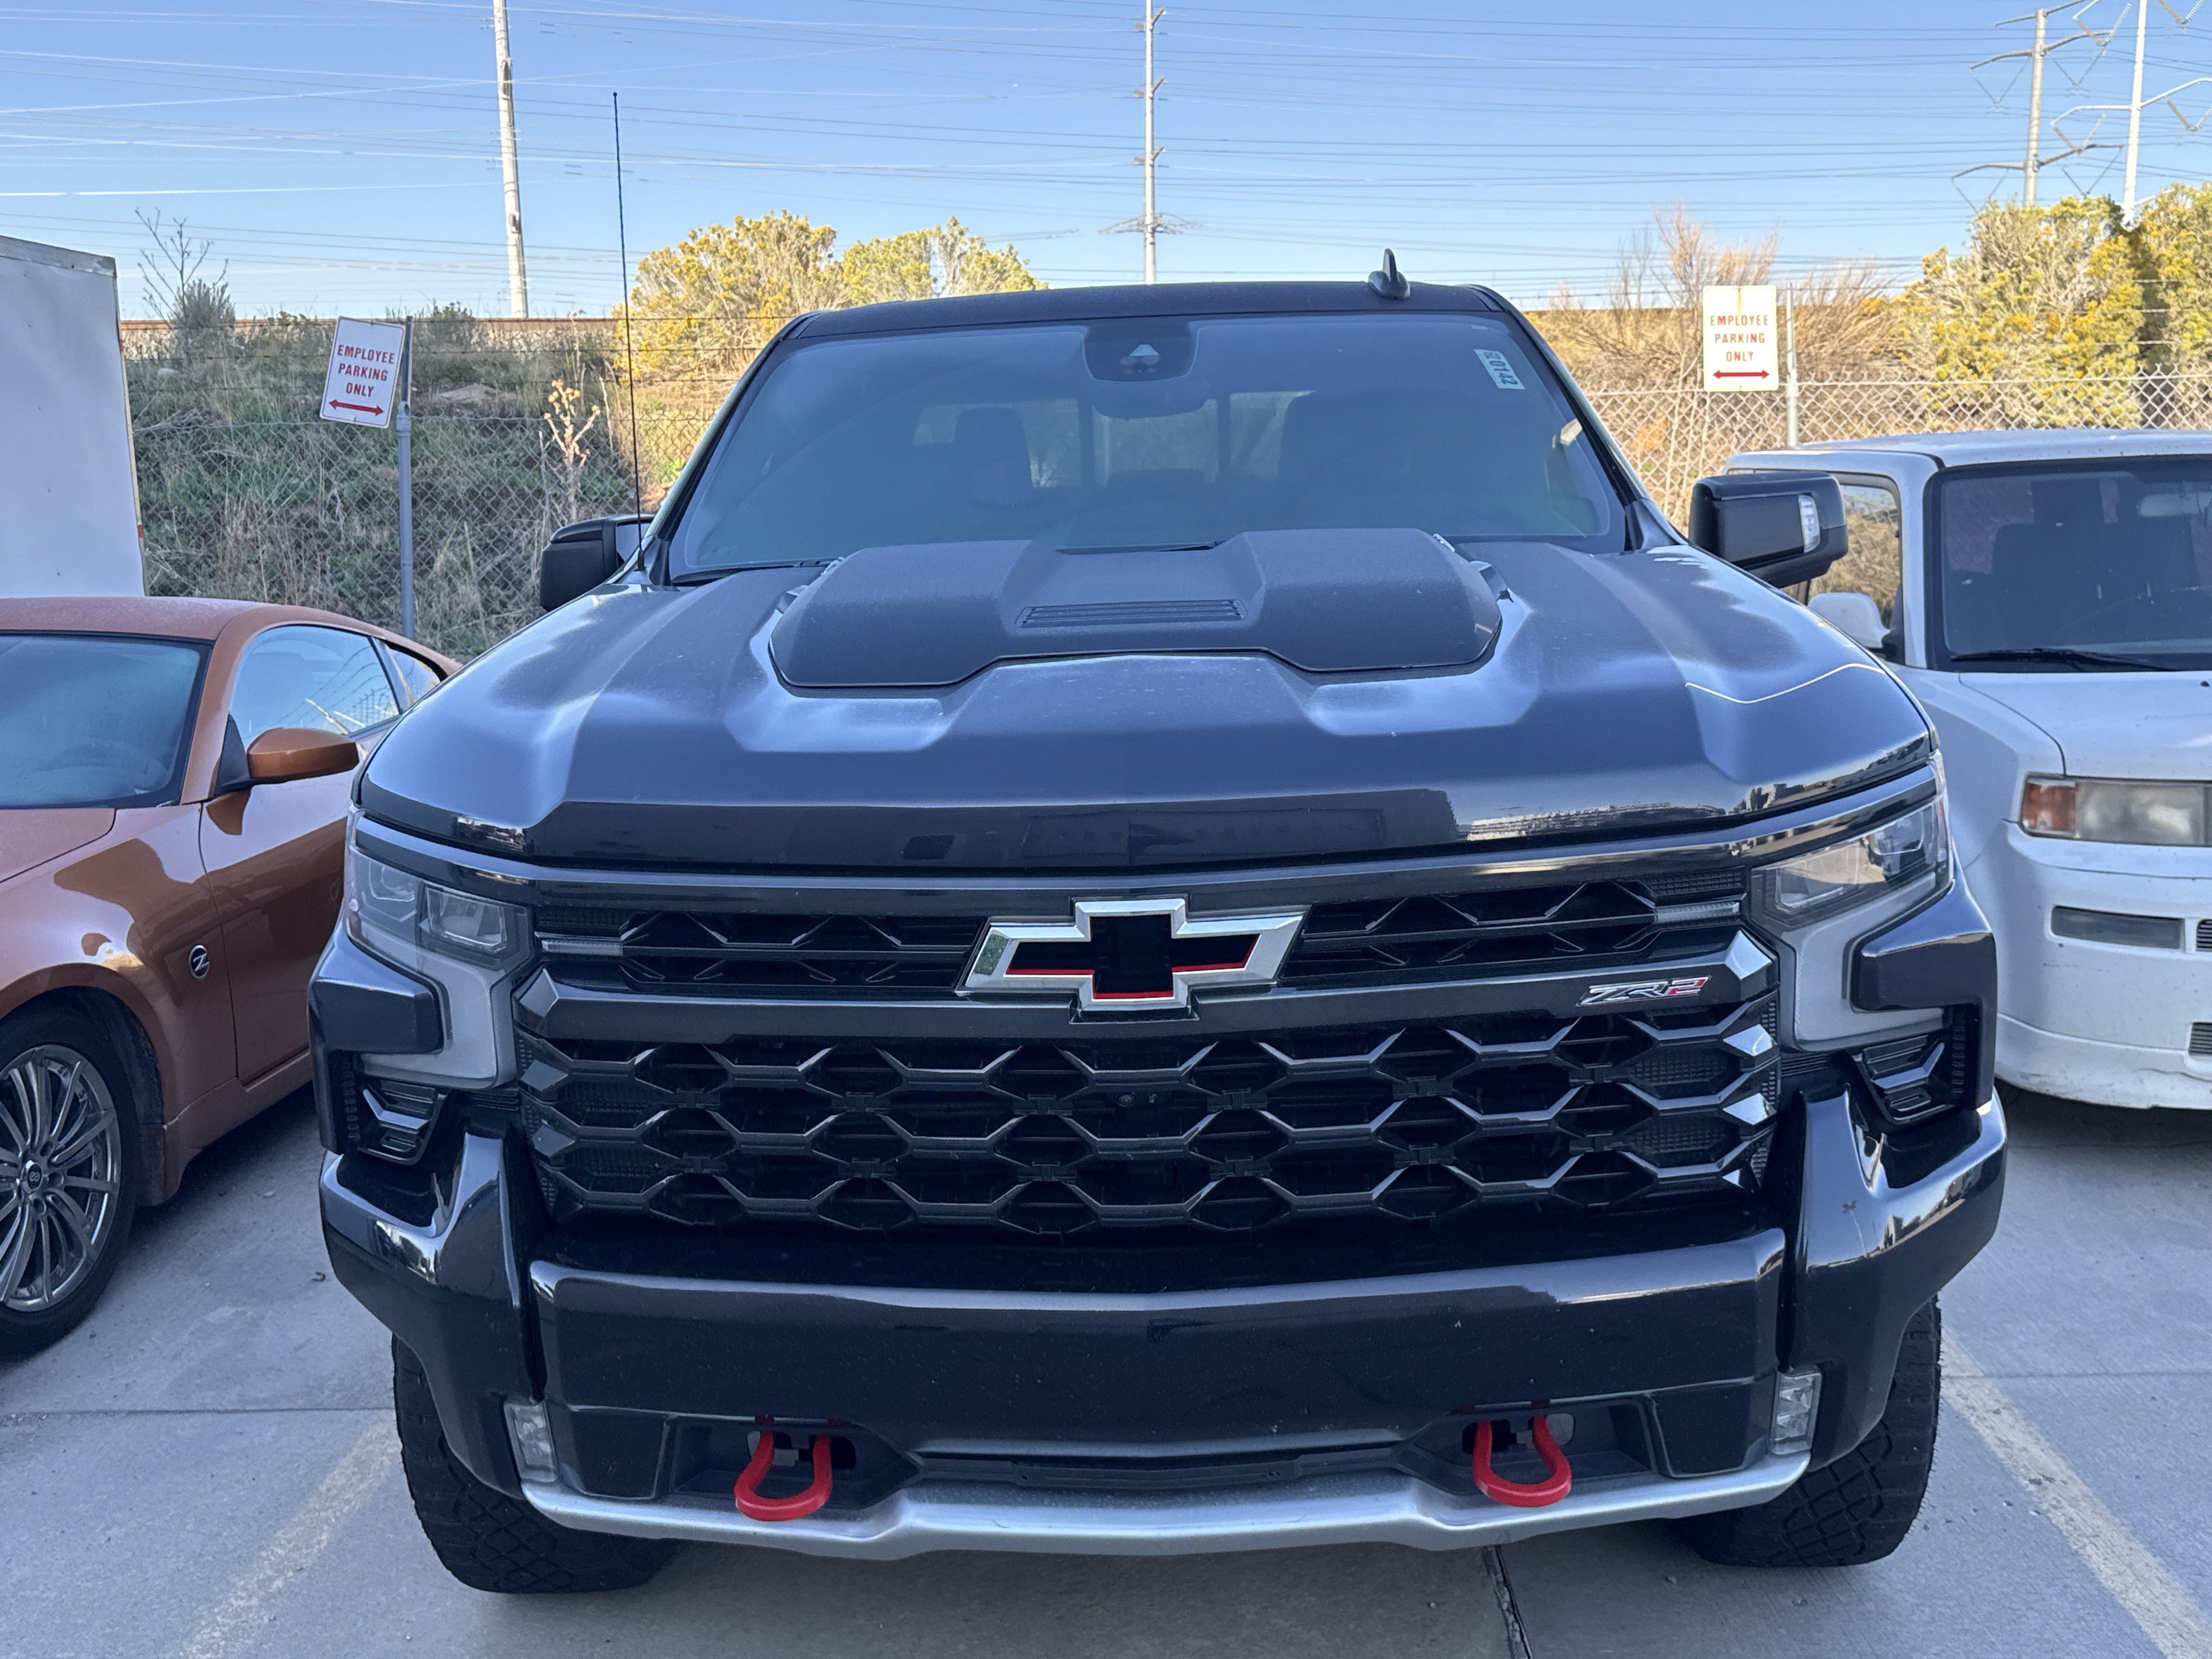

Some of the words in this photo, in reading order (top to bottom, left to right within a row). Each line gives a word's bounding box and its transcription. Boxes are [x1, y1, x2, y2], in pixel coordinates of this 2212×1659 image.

[1710, 315, 1769, 326] EMPLOYEE
[1715, 332, 1765, 343] PARKING
[337, 345, 395, 364] EMPLOYEE
[1726, 351, 1754, 362] ONLY
[338, 363, 388, 381] PARKING
[346, 382, 374, 397] ONLY
[1577, 975, 1711, 1006] ZR2
